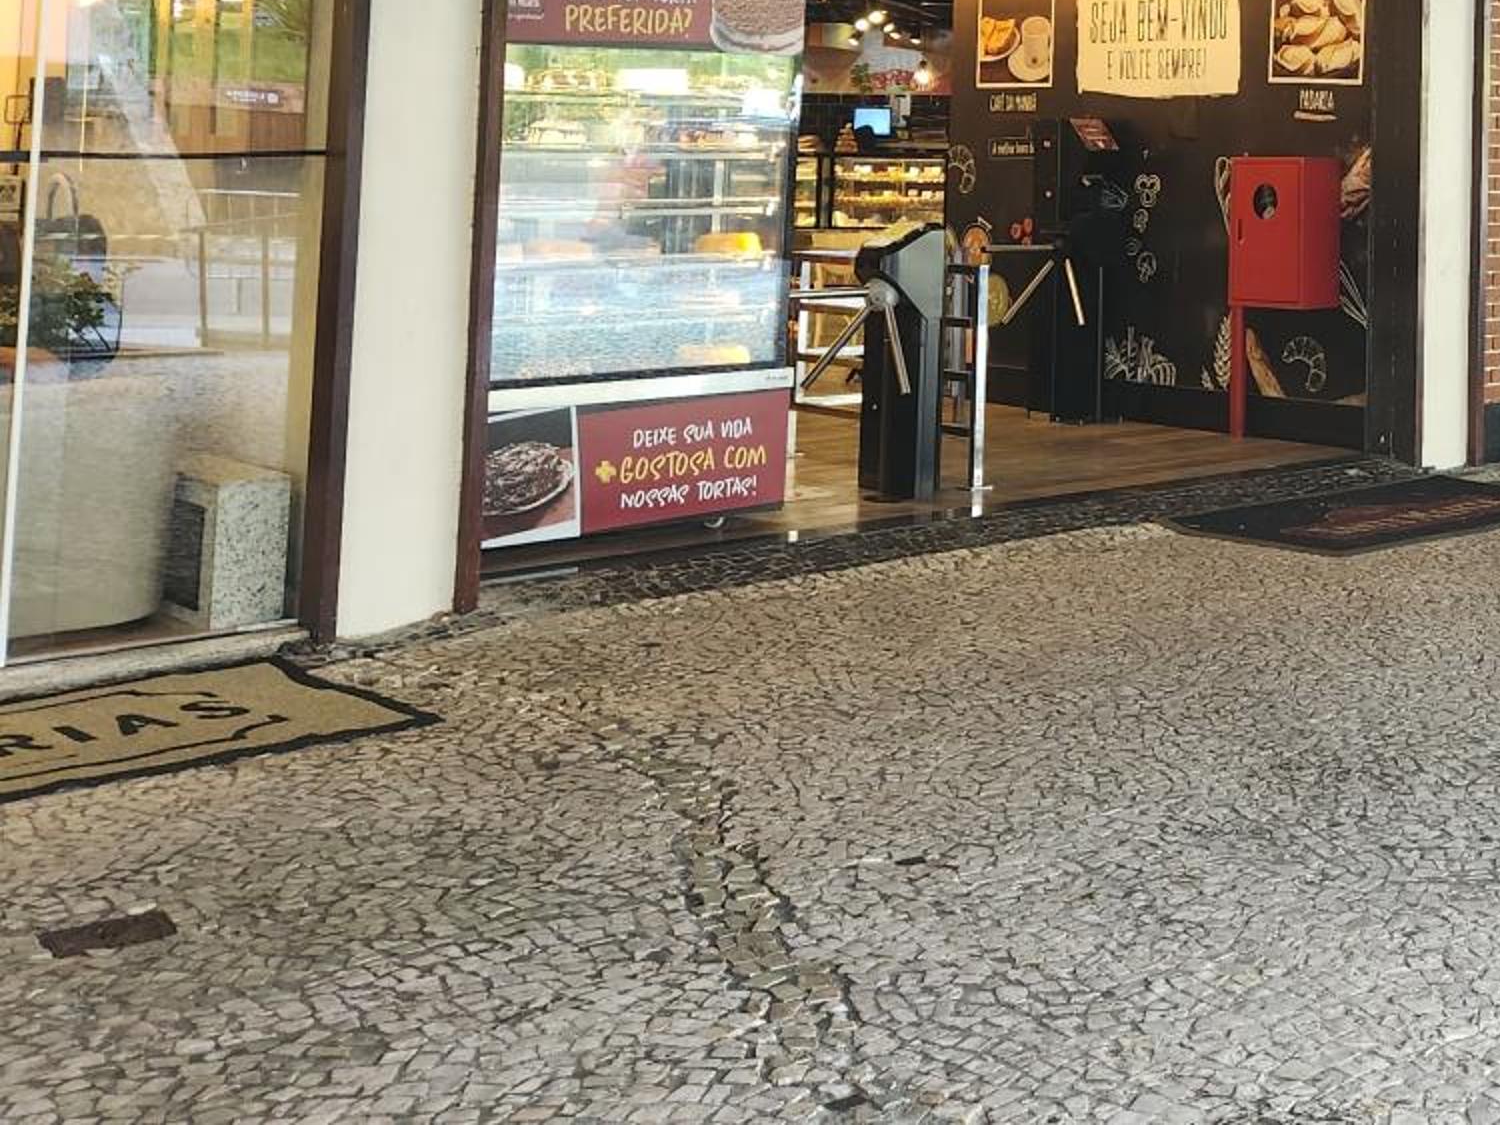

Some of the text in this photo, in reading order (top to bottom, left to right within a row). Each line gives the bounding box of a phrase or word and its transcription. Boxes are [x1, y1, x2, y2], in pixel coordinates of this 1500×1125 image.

[565, 4, 693, 39] PREFERIDA?
[1090, 1, 1127, 43] SEJA
[1119, 48, 1152, 79] VOLTE
[1300, 89, 1335, 110] PADARIA
[633, 416, 753, 448] DEIXE SUA VIDA
[724, 445, 768, 469] COM
[620, 475, 758, 509] NOSSAS TORTAS!
